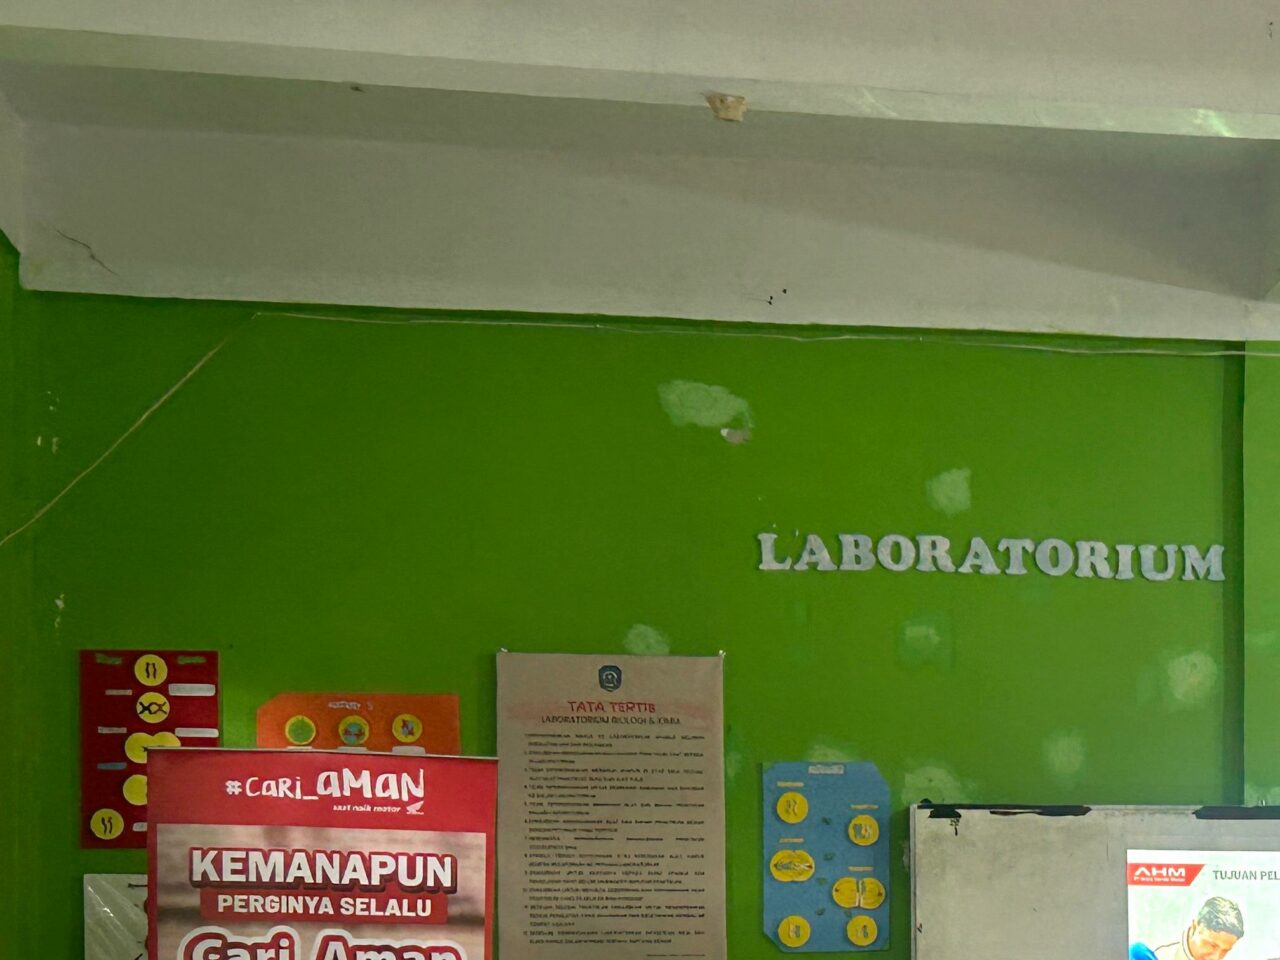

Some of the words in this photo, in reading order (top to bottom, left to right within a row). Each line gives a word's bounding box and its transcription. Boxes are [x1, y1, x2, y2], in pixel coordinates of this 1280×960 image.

[757, 532, 1226, 581] LABORATORIUM
[568, 701, 605, 713] TATA
[609, 702, 656, 713] TERTIB
[191, 849, 453, 888] KEMANAPUN
[1133, 866, 1186, 877] AHM
[1213, 869, 1257, 881] TUJUAN
[217, 894, 334, 915] PERGINYA
[340, 897, 432, 917] SELALU
